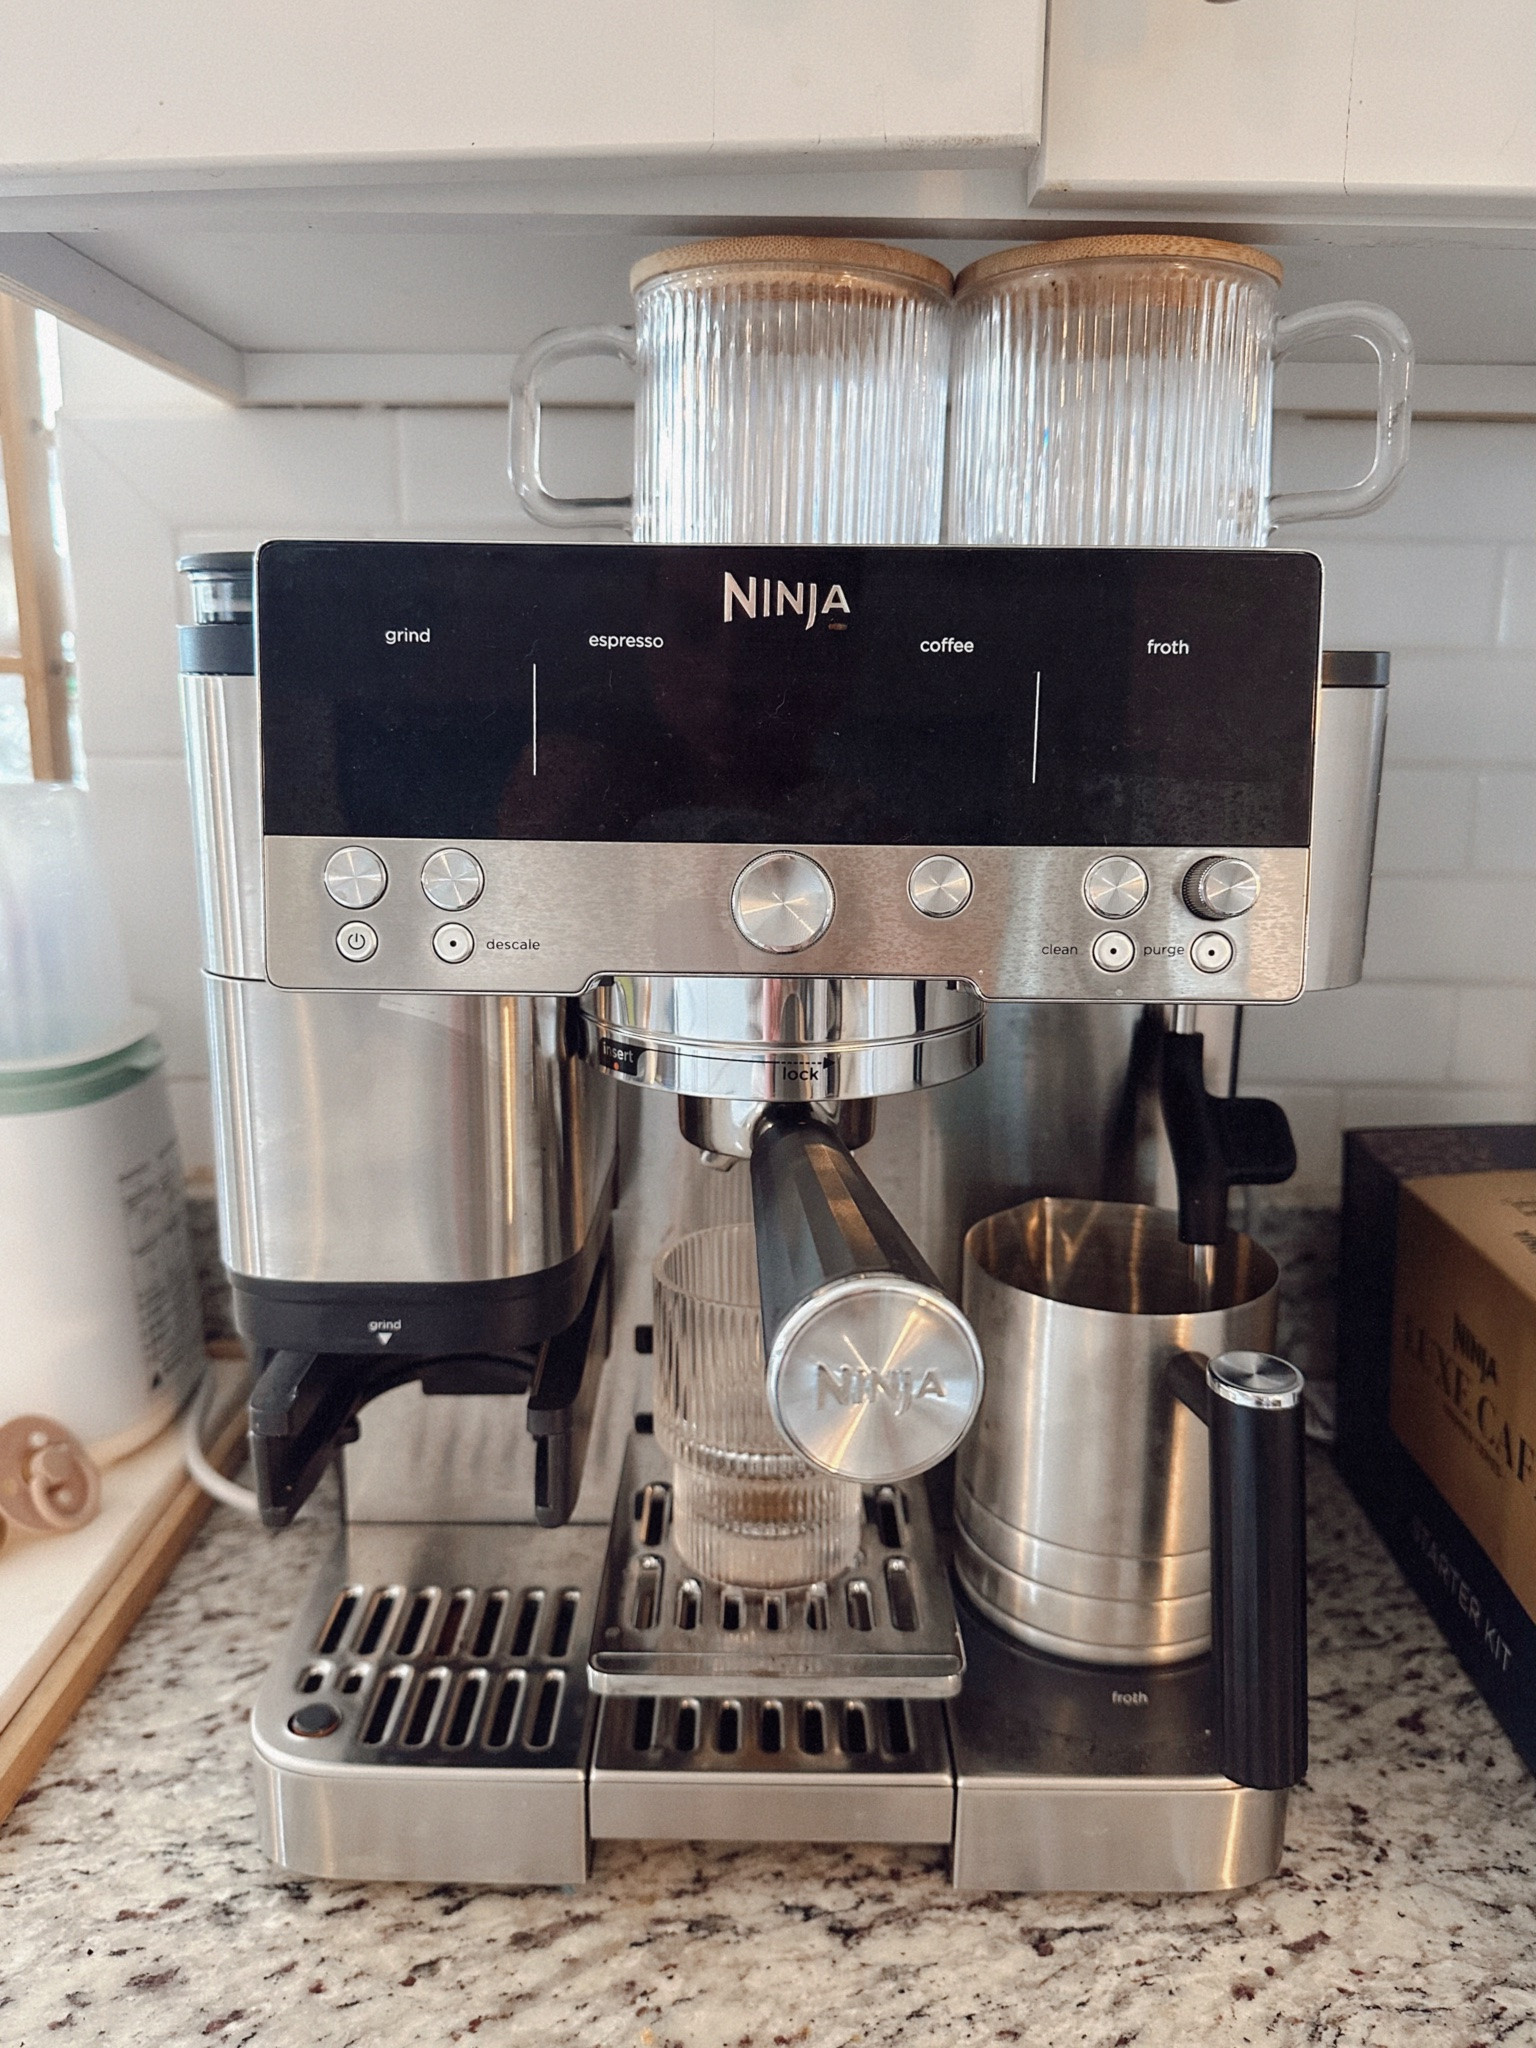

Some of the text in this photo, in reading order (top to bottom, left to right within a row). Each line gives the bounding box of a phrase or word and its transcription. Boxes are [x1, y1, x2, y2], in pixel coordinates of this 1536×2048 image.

[723, 571, 851, 631] NINJA
[384, 627, 431, 646] grind
[588, 634, 664, 650] espresso
[919, 637, 975, 653] coffee
[1146, 638, 1190, 655] froth
[486, 938, 541, 951] descale
[1041, 943, 1078, 955] clean
[1143, 945, 1185, 957] purge
[602, 1041, 634, 1063] insert
[782, 1066, 819, 1081] lock
[368, 1319, 402, 1332] grind
[816, 1361, 948, 1416] NINJA
[1476, 1394, 1536, 1501] CAF
[1484, 1617, 1513, 1671] KIT
[1111, 1690, 1149, 1706] froth
